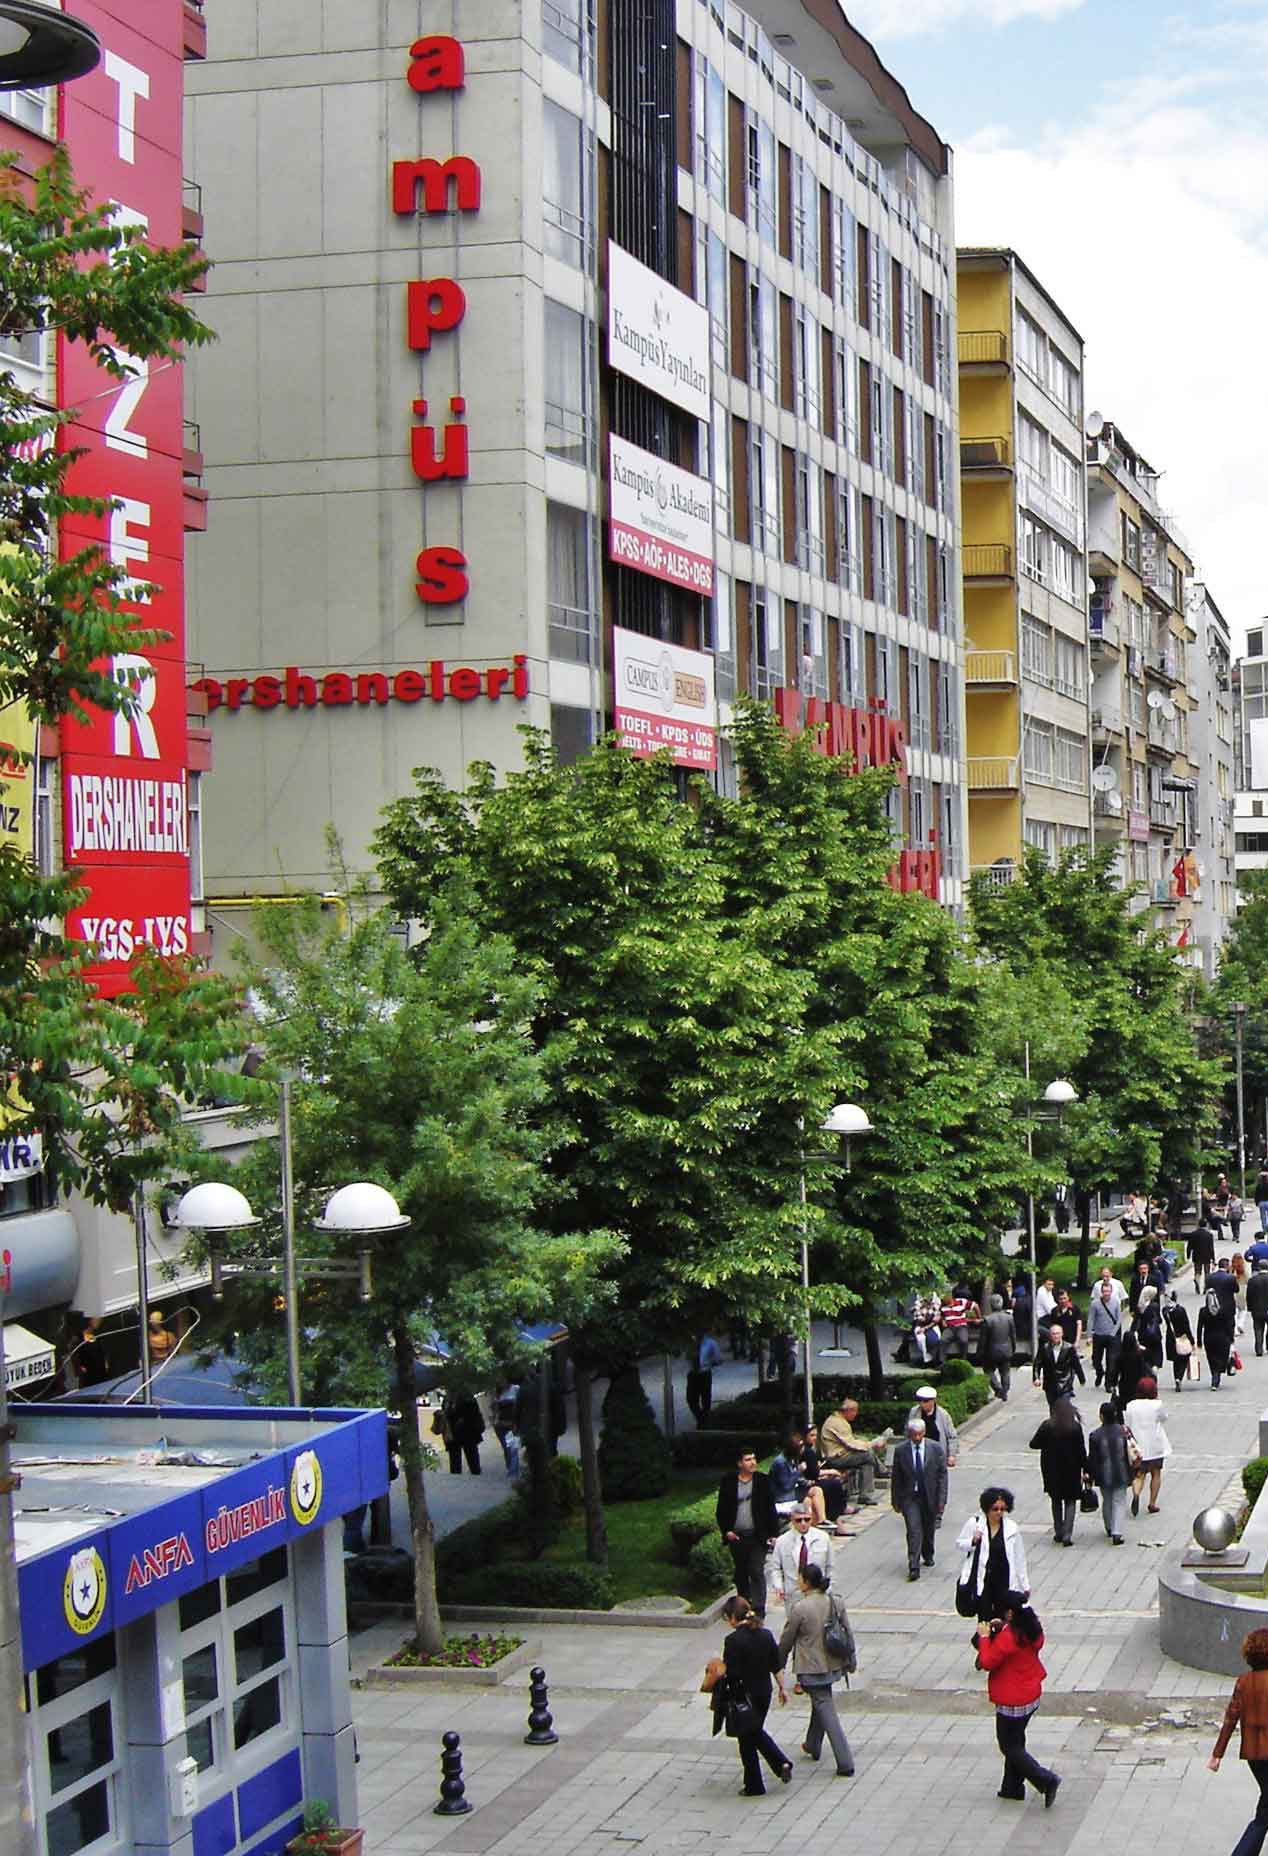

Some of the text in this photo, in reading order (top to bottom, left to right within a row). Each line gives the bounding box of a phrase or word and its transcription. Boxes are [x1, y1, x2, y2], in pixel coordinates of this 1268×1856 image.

[613, 453, 655, 501] Kampüs
[619, 713, 655, 737] TOEFL
[125, 1484, 287, 1595] ANFA GÜVENLİK
